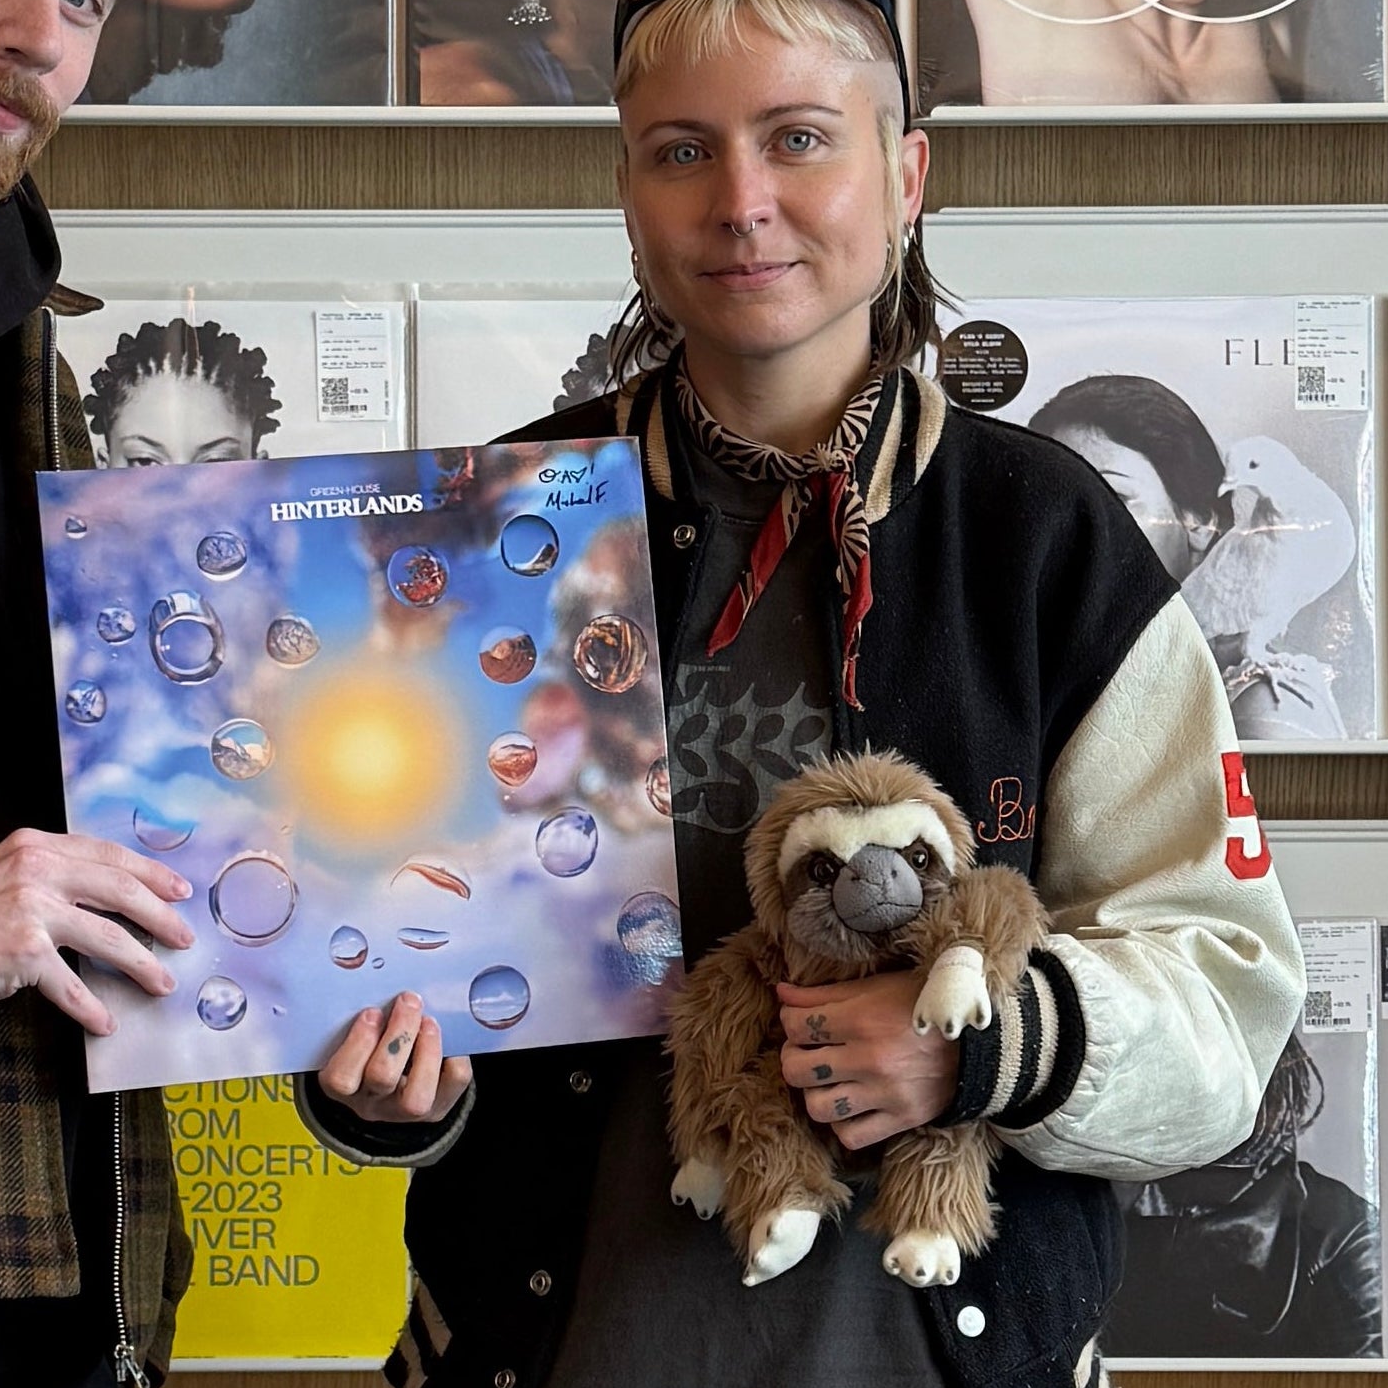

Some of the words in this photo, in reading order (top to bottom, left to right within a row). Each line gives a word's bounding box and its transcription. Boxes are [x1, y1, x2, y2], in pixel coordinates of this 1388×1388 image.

[310, 483, 381, 497] GREEN-HOUSE
[270, 493, 424, 522] HINTERLANDS
[1221, 750, 1273, 880] 5
[209, 1254, 321, 1287] BAND
